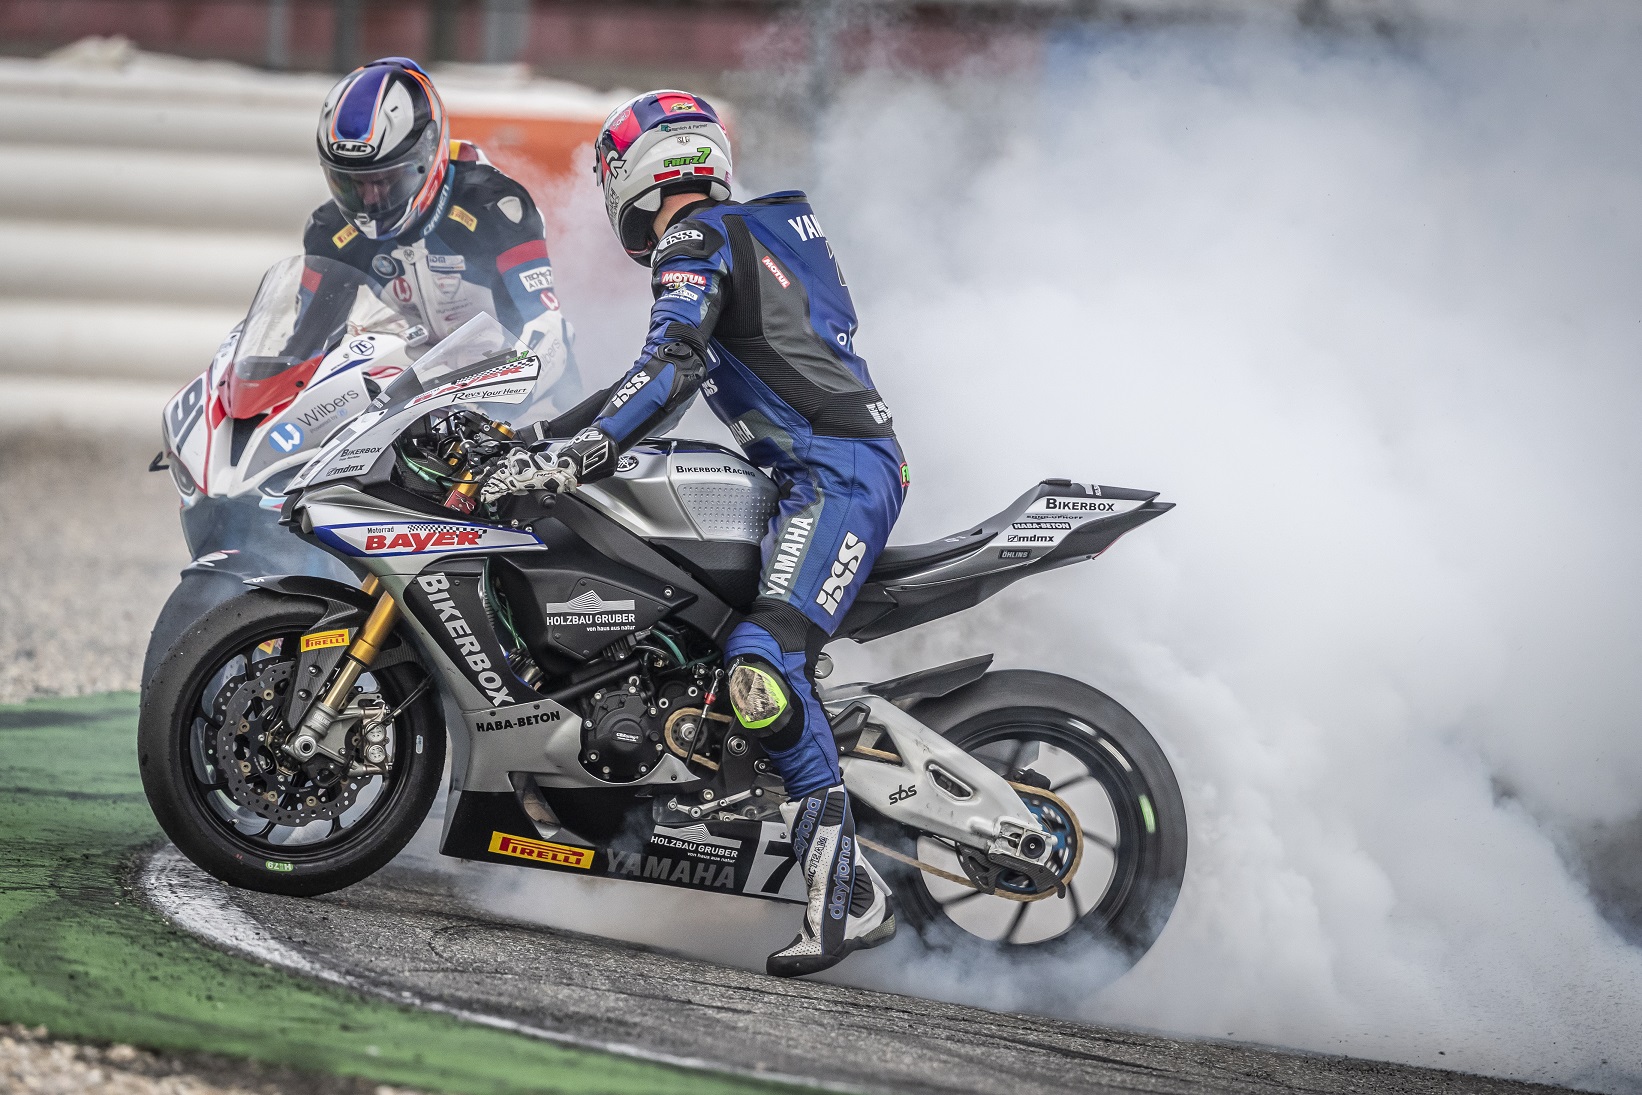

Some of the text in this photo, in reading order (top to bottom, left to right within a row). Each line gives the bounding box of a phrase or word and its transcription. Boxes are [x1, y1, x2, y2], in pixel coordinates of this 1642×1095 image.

[335, 143, 368, 153] HJC
[662, 272, 705, 285] MOTUL
[762, 257, 790, 289] MOTUL
[482, 389, 503, 399] Your
[503, 387, 527, 395] Heart
[297, 389, 360, 427] Wilbers
[340, 446, 382, 458] BIKERBOX
[1045, 498, 1115, 512] BIKERBOX
[367, 526, 395, 535] Motorrad
[1013, 522, 1070, 530] HABA-BETON
[365, 531, 480, 553] BAYER
[1018, 534, 1055, 543] mdmx
[766, 517, 814, 595] YAMAHA
[546, 613, 636, 626] HOLZBAU GRUBER
[305, 633, 345, 648] PIRELLI
[417, 572, 516, 707] BIKERBOX
[475, 710, 561, 733] HABA-BETON
[888, 784, 917, 806] sbs
[499, 836, 585, 866] PIRELLI
[650, 835, 739, 858] HOLZBAU GRUBER
[606, 848, 735, 889] YAMAHA
[828, 835, 852, 920] daytona
